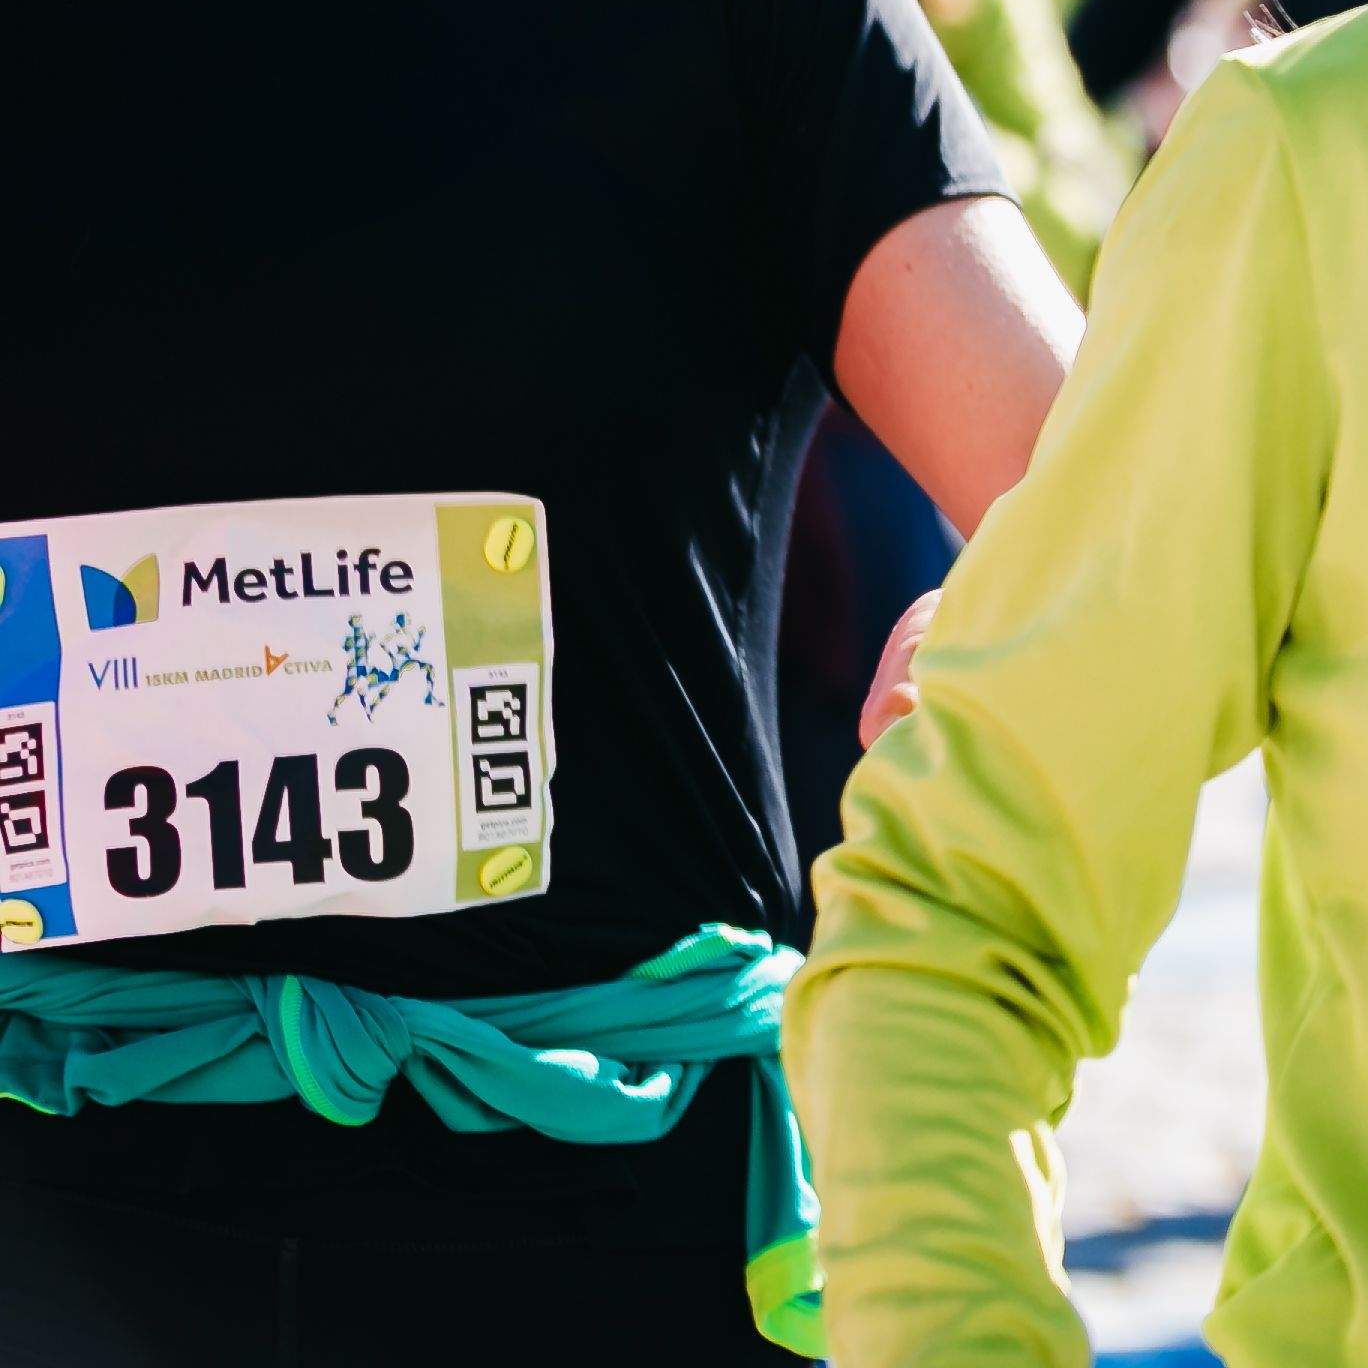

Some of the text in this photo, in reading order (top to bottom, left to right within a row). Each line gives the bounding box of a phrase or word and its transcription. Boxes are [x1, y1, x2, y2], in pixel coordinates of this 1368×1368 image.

[183, 549, 414, 606] MetLife
[88, 657, 139, 690] VIII
[104, 748, 414, 898] 3143
